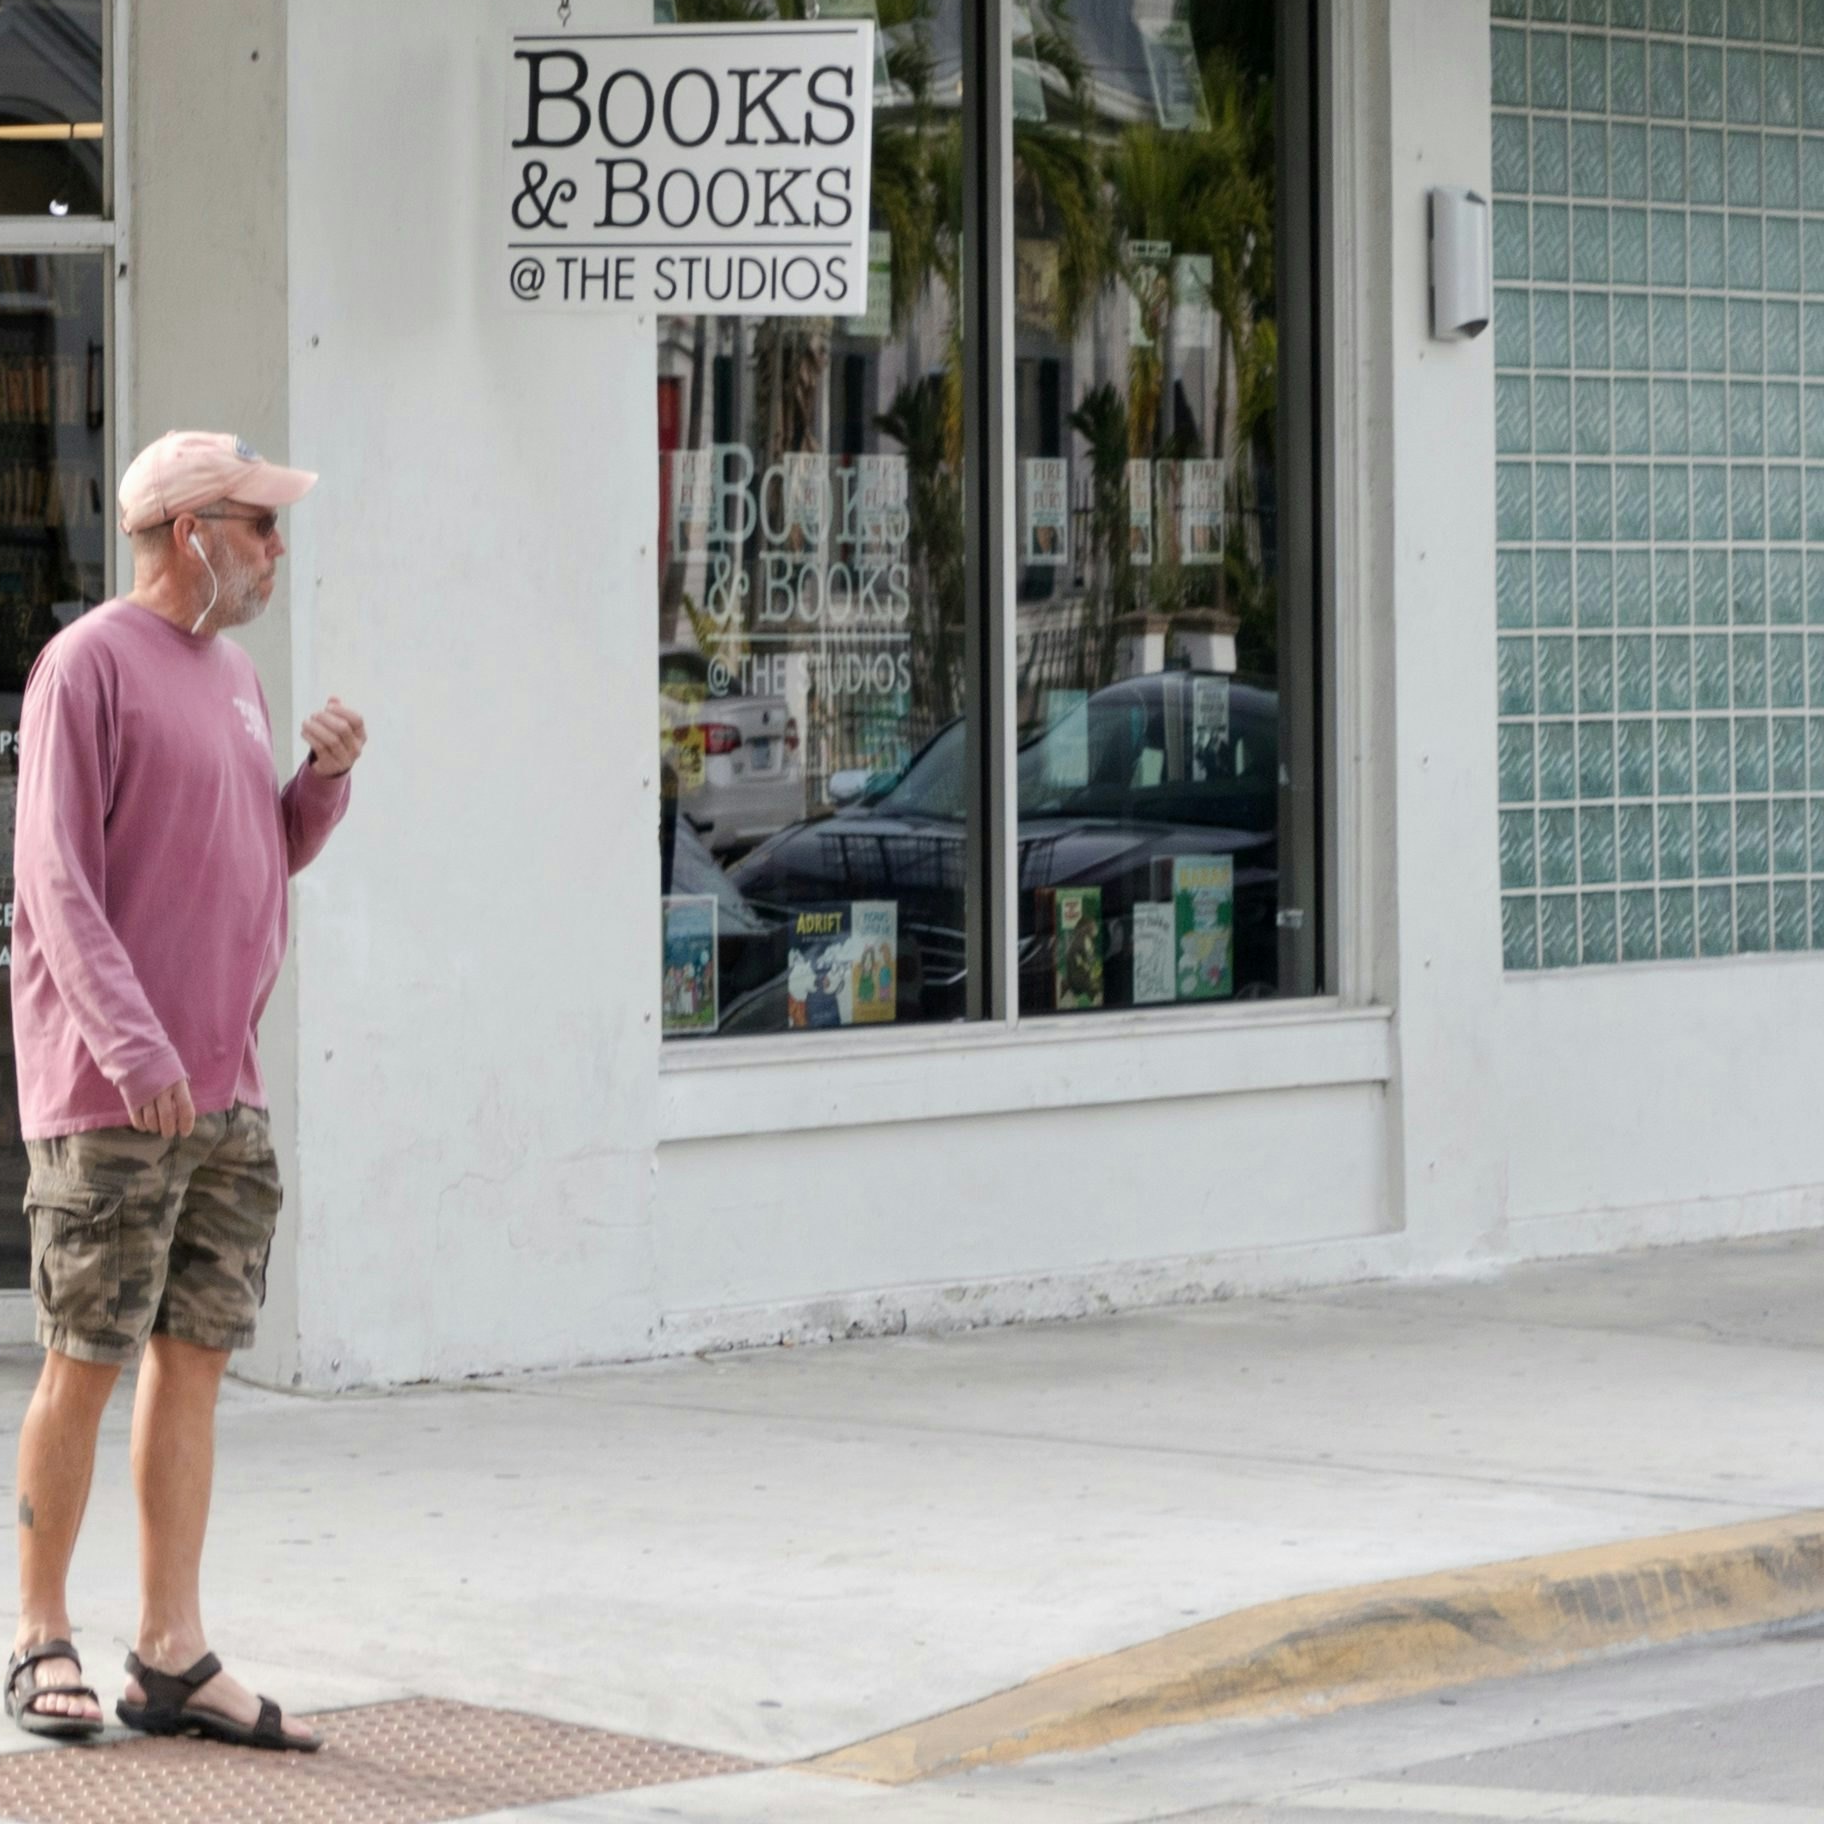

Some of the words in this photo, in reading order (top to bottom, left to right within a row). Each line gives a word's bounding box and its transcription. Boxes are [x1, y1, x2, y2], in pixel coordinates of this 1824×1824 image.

[511, 49, 855, 149] BOOKS
[510, 160, 578, 230] &
[593, 157, 853, 229] BOOKS
[509, 256, 546, 301] @
[555, 257, 636, 301] THE
[653, 256, 849, 302] STUDIOS
[707, 442, 911, 544] BOOKS
[706, 553, 750, 626] &
[759, 551, 911, 623] BOOKS
[706, 654, 731, 697] @
[736, 652, 786, 696] THE
[798, 652, 912, 695] STUDIOS
[795, 911, 844, 935] ADRIFT
